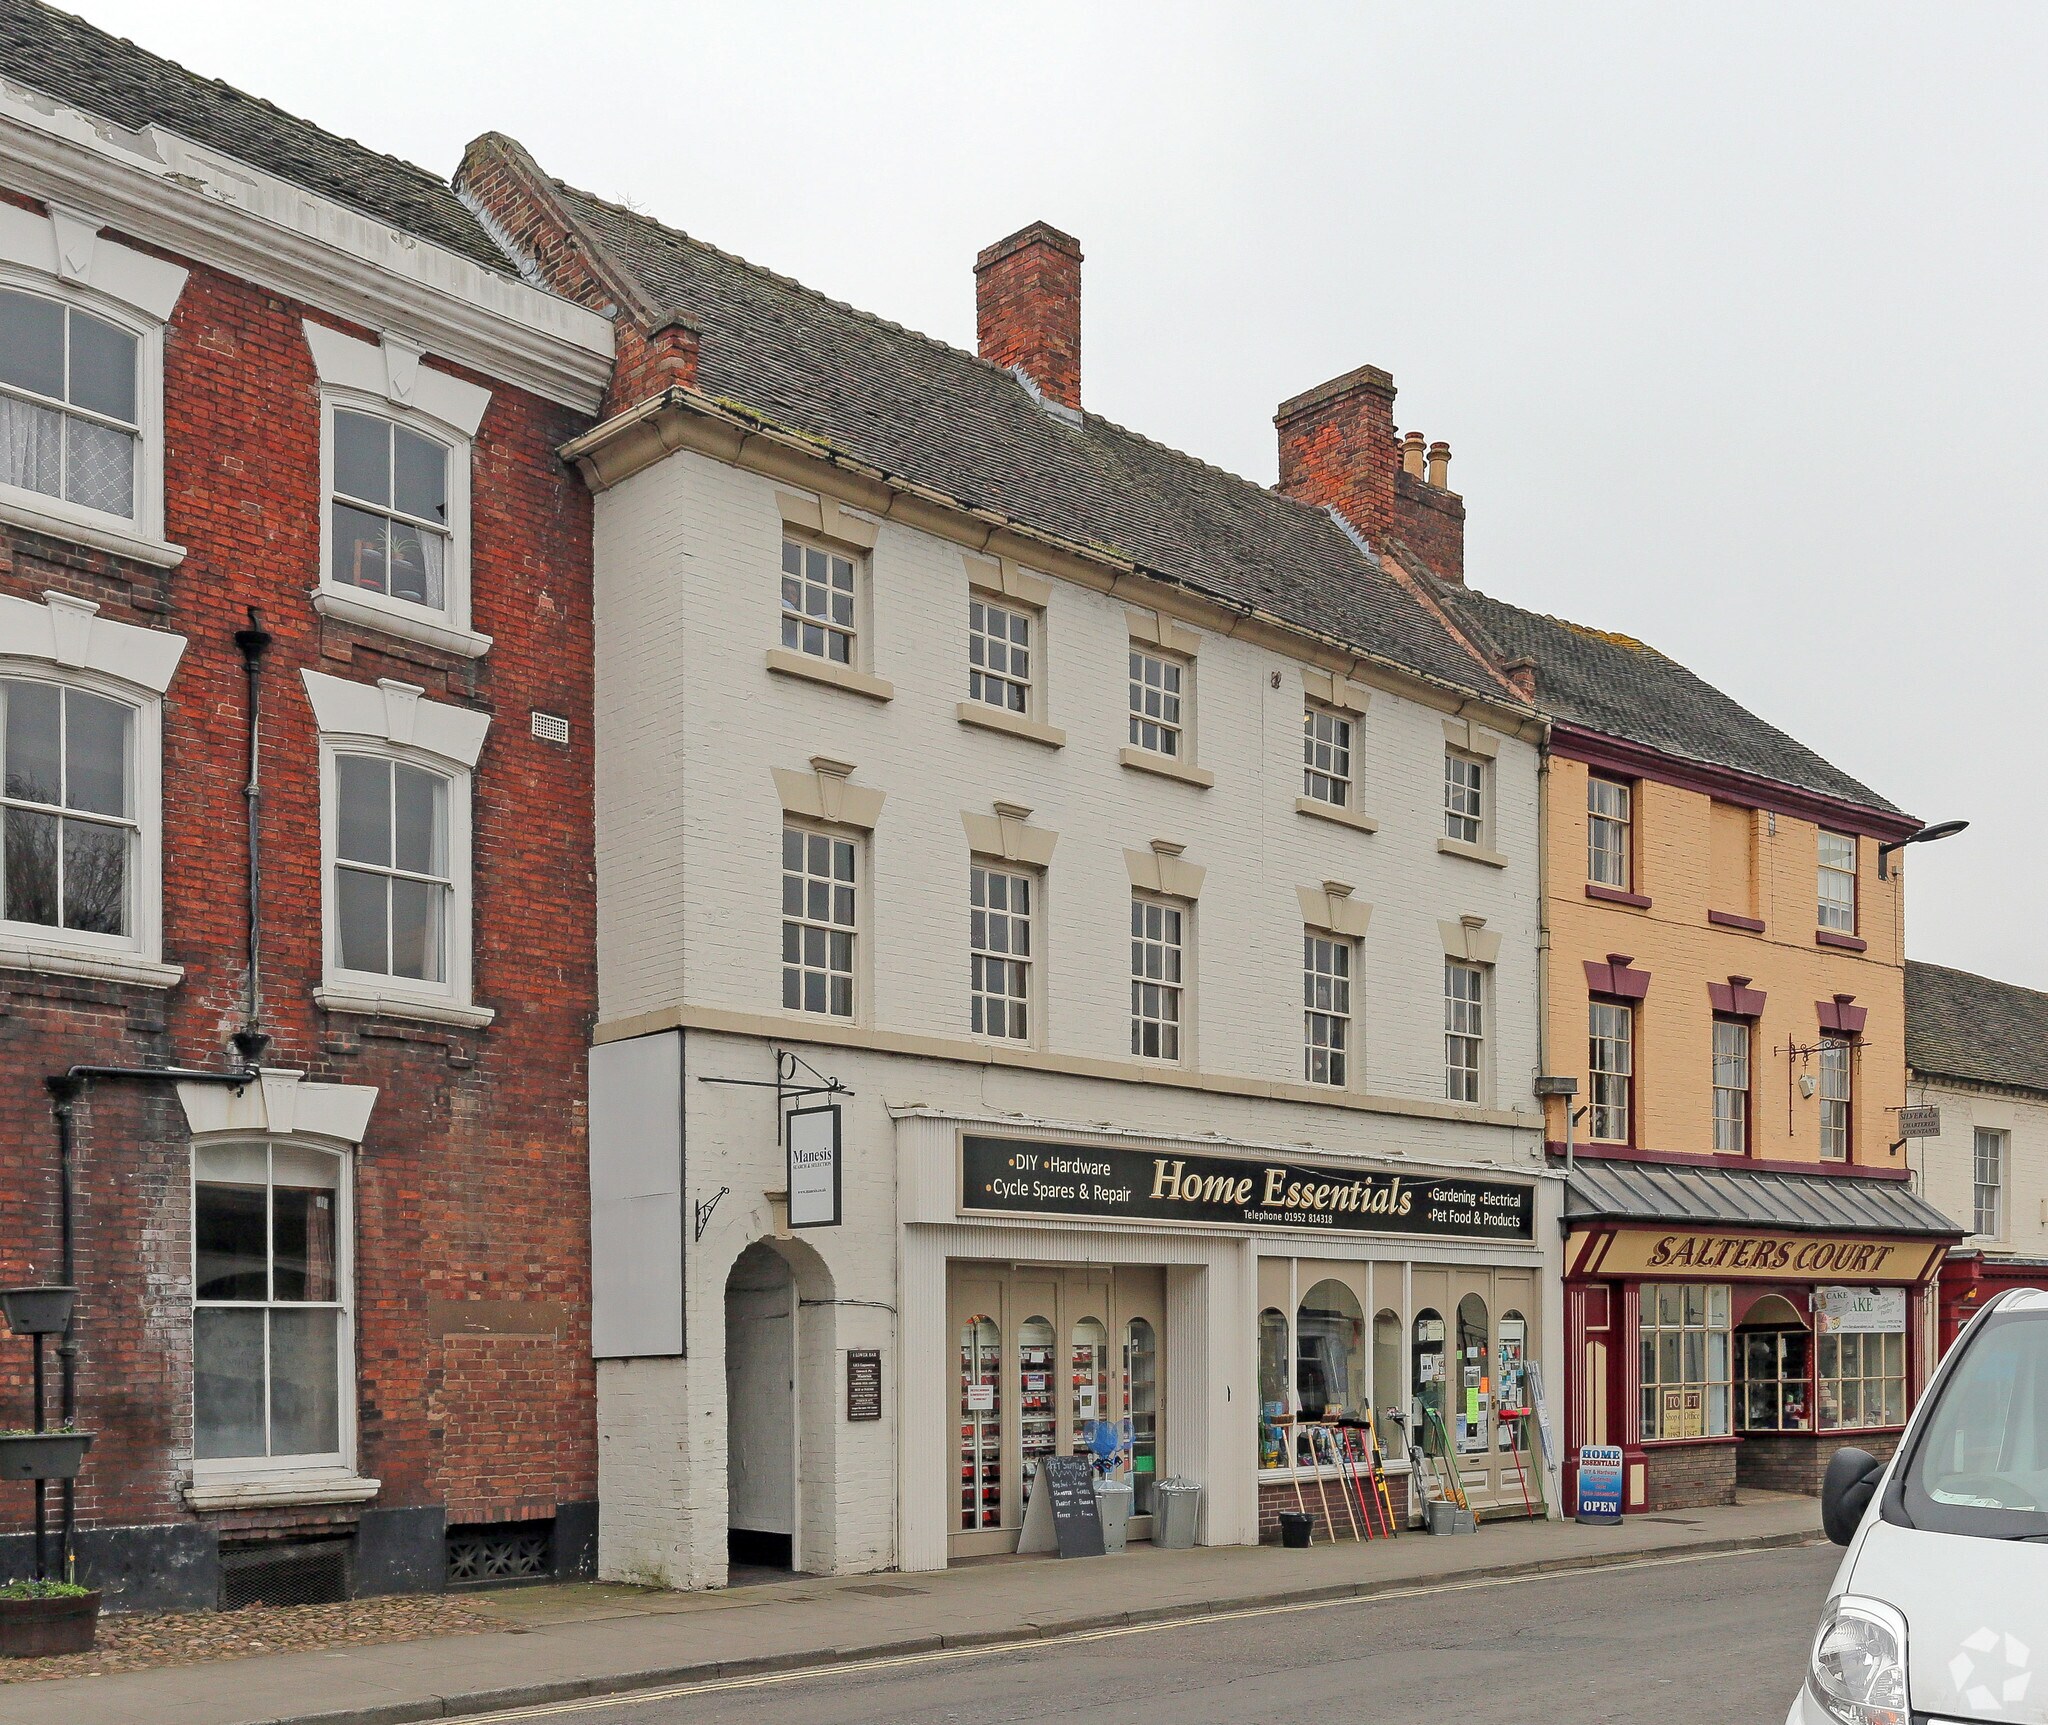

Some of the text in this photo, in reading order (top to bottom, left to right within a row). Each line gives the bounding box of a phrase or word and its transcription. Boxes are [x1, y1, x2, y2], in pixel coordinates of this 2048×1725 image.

[1900, 1112, 1923, 1120] SILVER
[793, 1147, 832, 1163] Manesis
[1016, 1153, 1111, 1176] DIY Hardware
[993, 1178, 1132, 1204] Cycle Spares & Repair
[1149, 1159, 1412, 1216] Home Essentials
[1432, 1187, 1521, 1208] Gardening Electrical
[1243, 1209, 1333, 1224] Telephone 01952 814318
[1432, 1208, 1520, 1227] Pet Food & Products
[1647, 1236, 1894, 1272] SALTERS COURT
[1826, 1291, 1848, 1300] CAKE
[1850, 1297, 1873, 1312] AKE
[1667, 1396, 1680, 1408] TO
[1581, 1449, 1620, 1460] HOME
[1581, 1459, 1620, 1467] ESSENTIALS
[1583, 1500, 1617, 1512] OPEN
